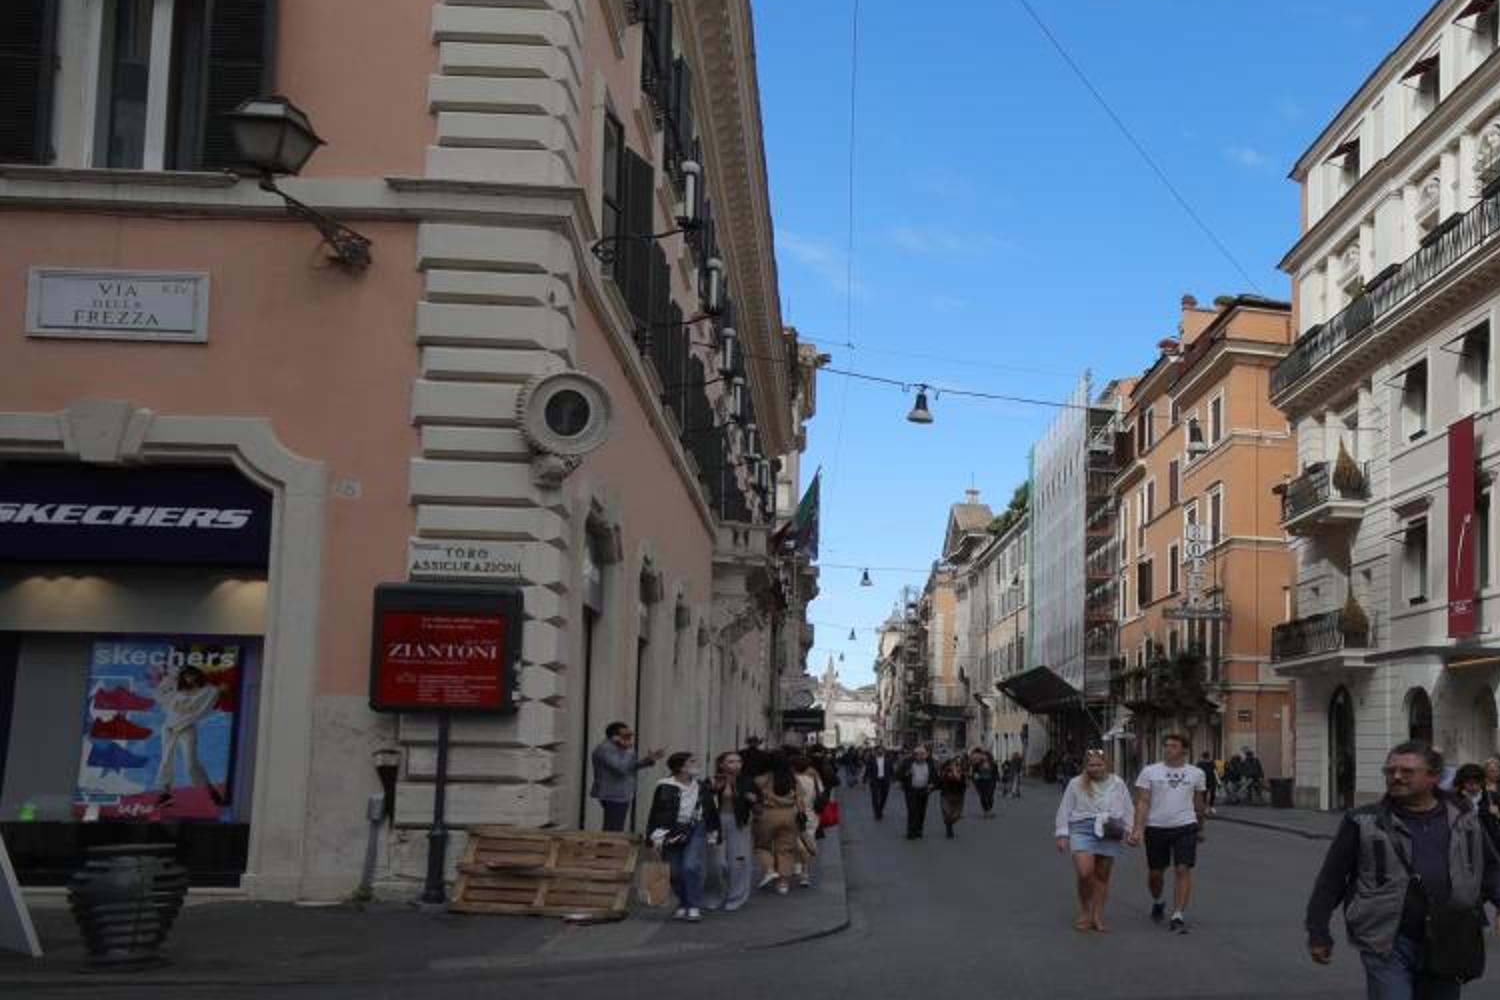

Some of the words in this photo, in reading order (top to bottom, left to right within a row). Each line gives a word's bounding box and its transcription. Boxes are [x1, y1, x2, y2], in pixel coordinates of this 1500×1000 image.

[98, 282, 138, 297] VIA
[73, 310, 159, 325] FREZZA
[446, 548, 489, 559] TORO
[412, 560, 521, 573] ASSICURAZIONI
[94, 644, 237, 667] skechers
[387, 642, 498, 660] ZIANTONI
